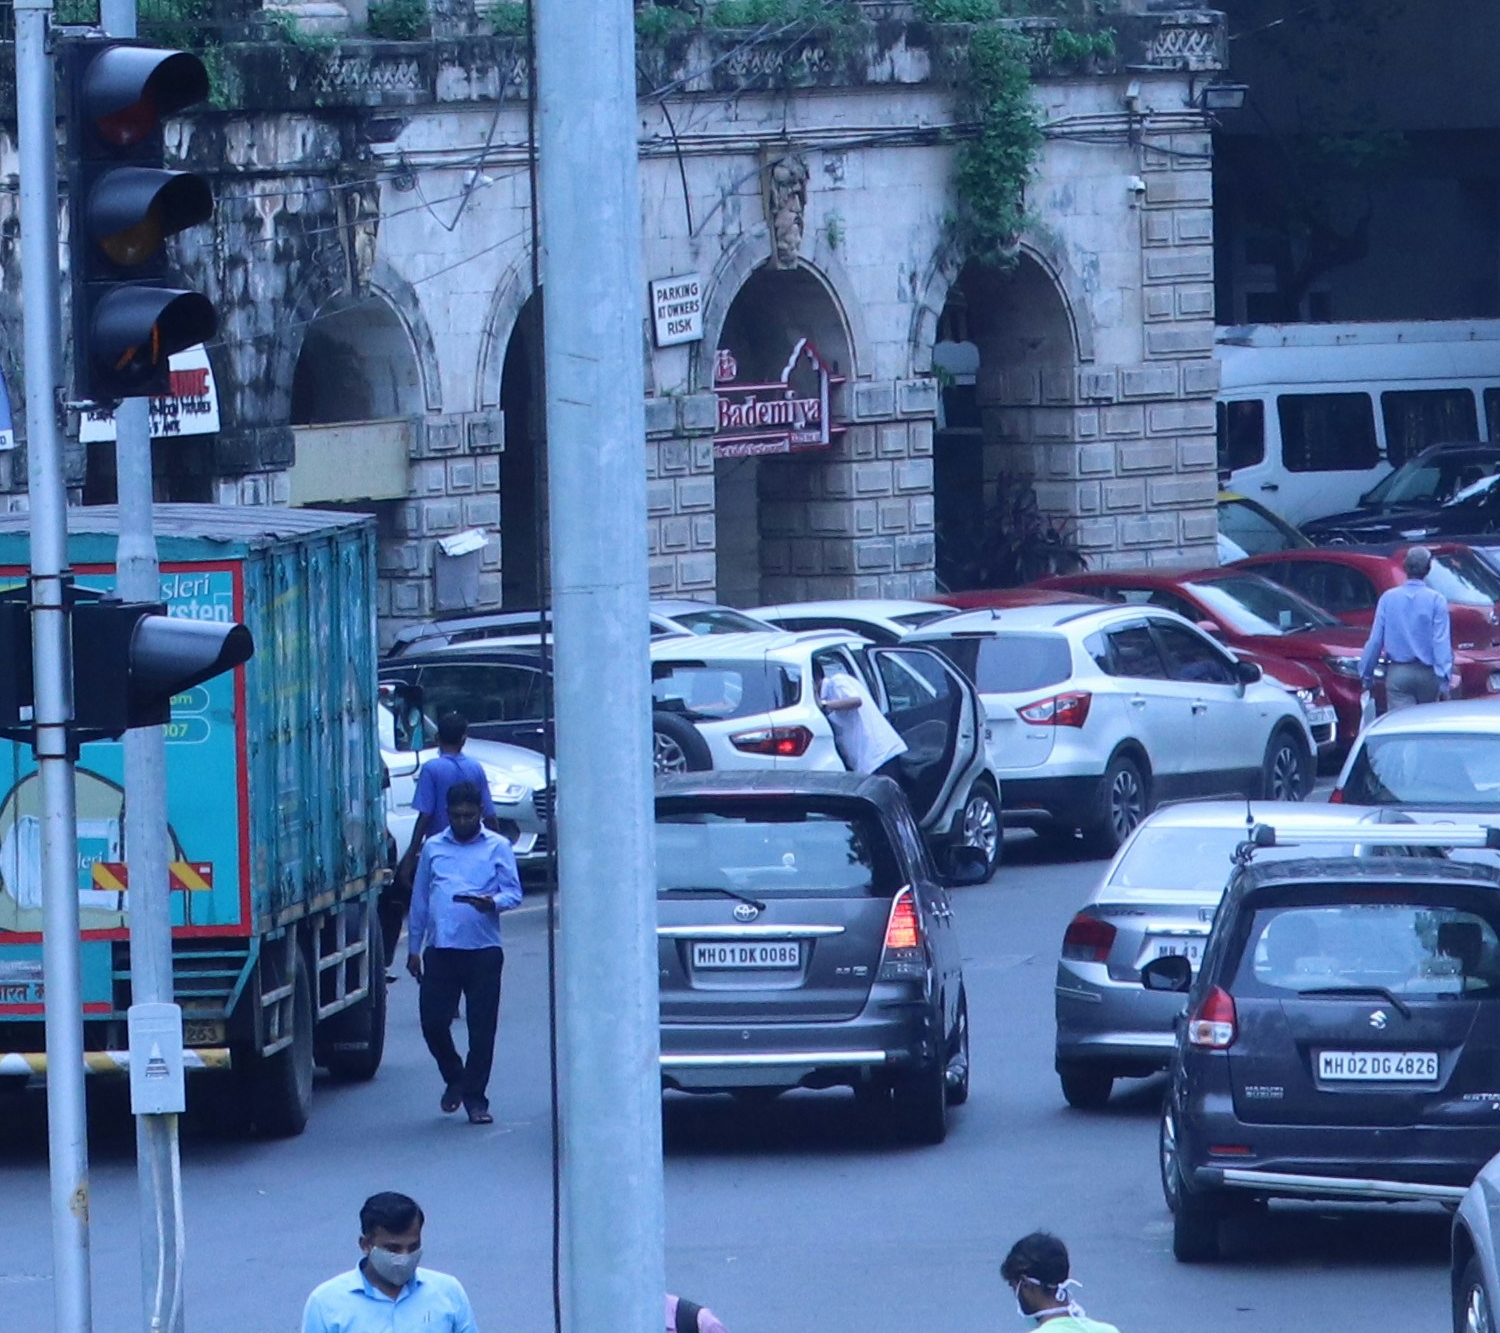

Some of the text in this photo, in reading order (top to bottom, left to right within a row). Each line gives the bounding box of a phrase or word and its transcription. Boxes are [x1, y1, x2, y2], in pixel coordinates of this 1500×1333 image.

[657, 282, 698, 303] PARKING
[658, 299, 699, 320] AT OWNERS
[667, 318, 692, 336] RISK
[717, 390, 820, 430] Bademiya
[160, 574, 210, 601] sleri
